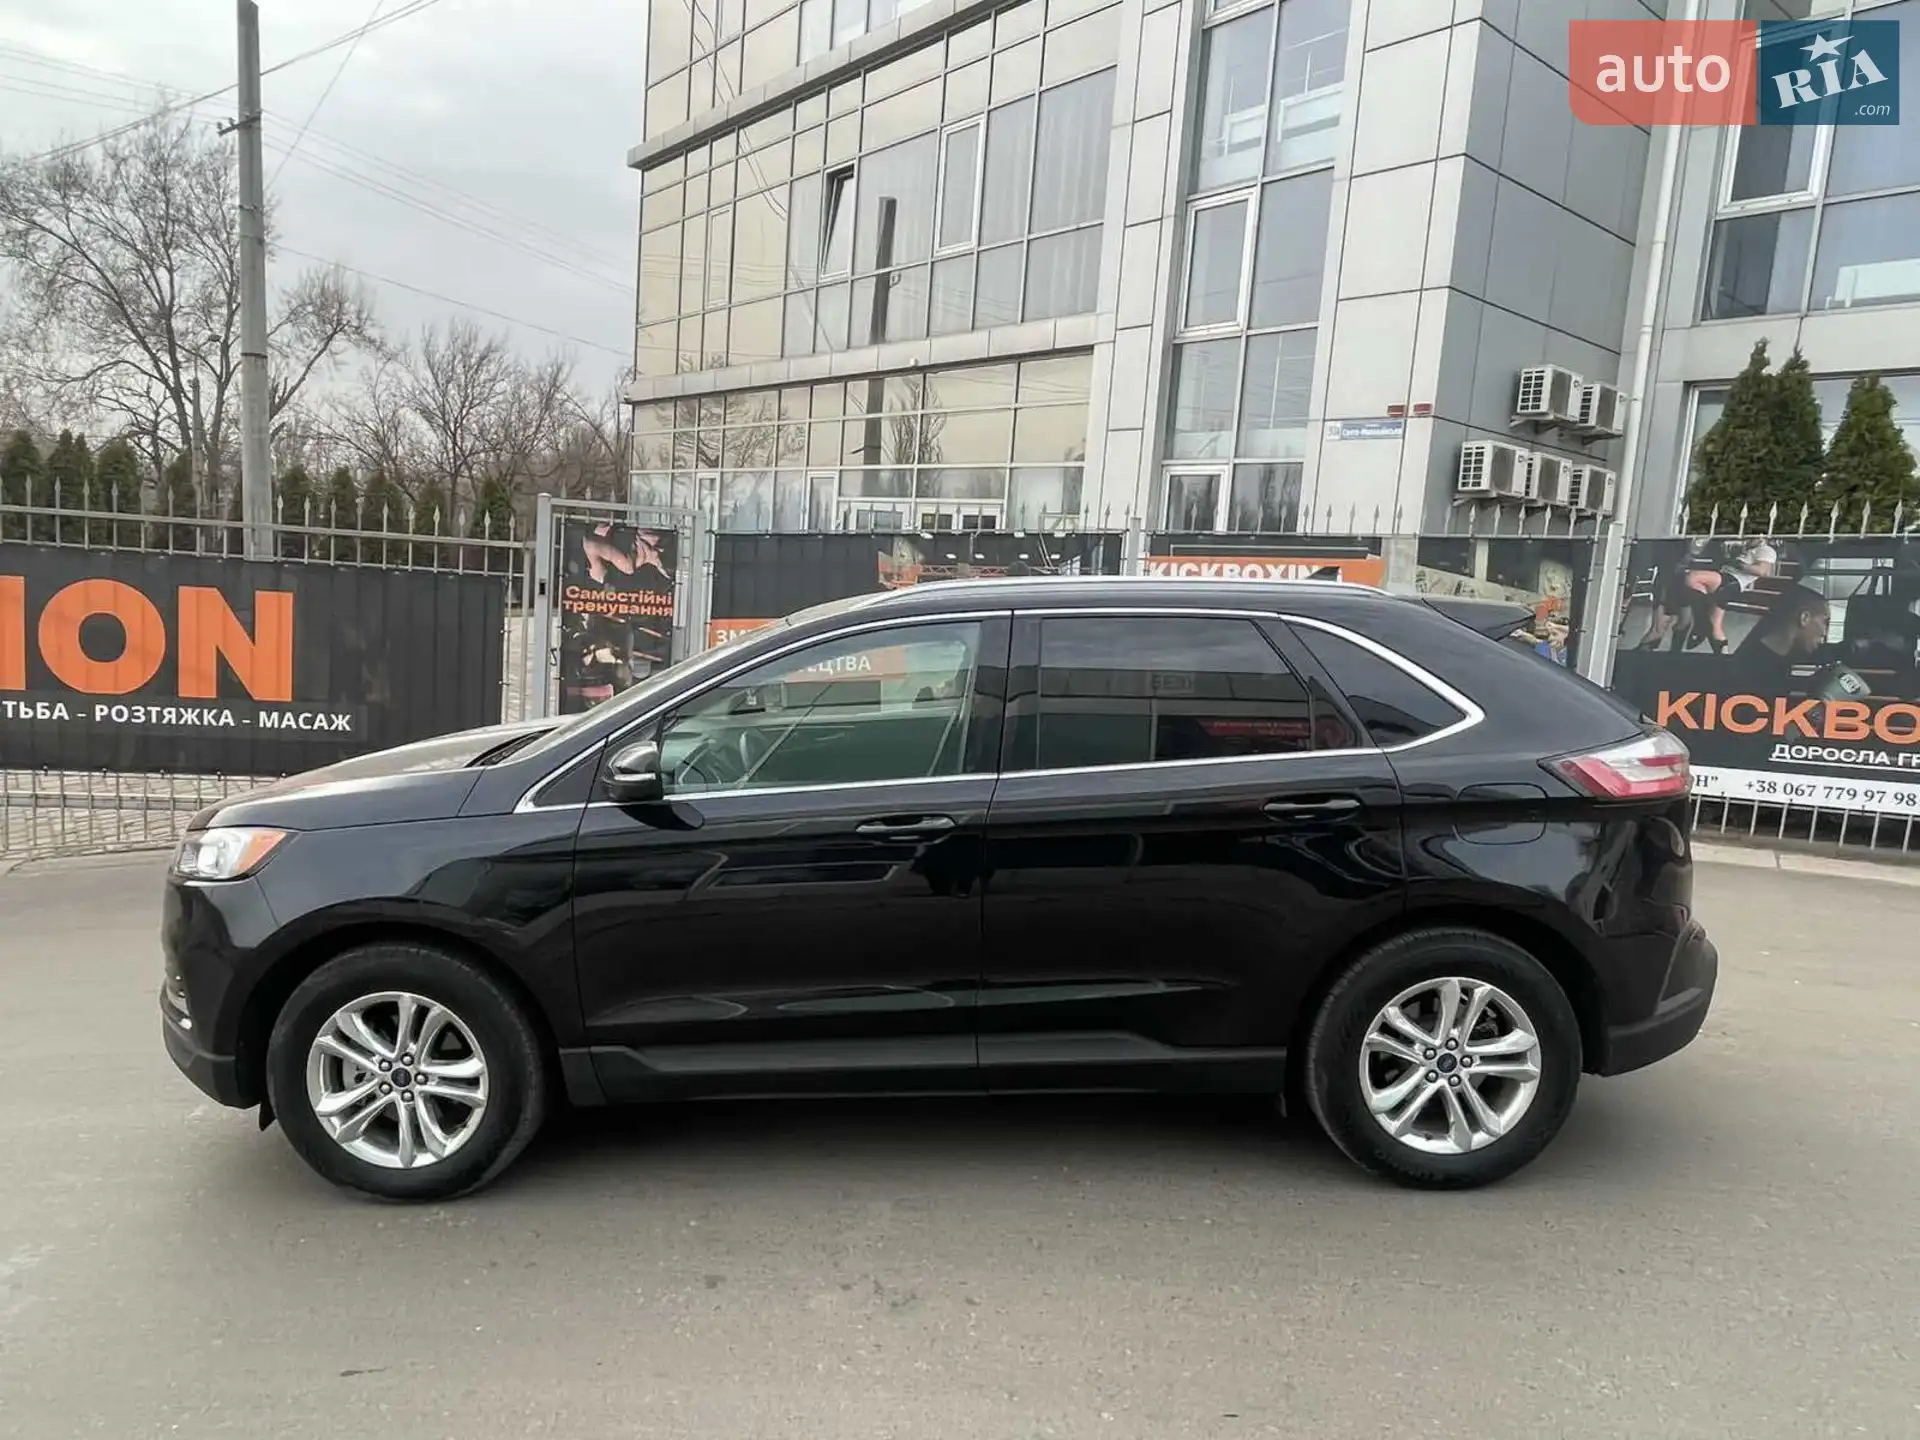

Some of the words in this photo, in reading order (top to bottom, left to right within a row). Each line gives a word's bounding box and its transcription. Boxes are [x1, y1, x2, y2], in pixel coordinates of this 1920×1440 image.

[1150, 562, 1343, 583] KICKBOXIN
[565, 585, 673, 606] Самостійні
[562, 600, 673, 617] тренування
[2, 700, 70, 721] ТЬБА
[95, 703, 235, 727] РОЗТЯЖКА
[258, 711, 352, 732] МАСАЖ
[1656, 690, 1920, 745] KICKBO
[1771, 743, 1891, 766] ДОРОСЛА
[1745, 779, 1778, 794] +38
[1783, 782, 1817, 798] 067
[1823, 786, 1858, 801] 779
[1863, 789, 1887, 804] 97
[1893, 791, 1917, 807] 98
